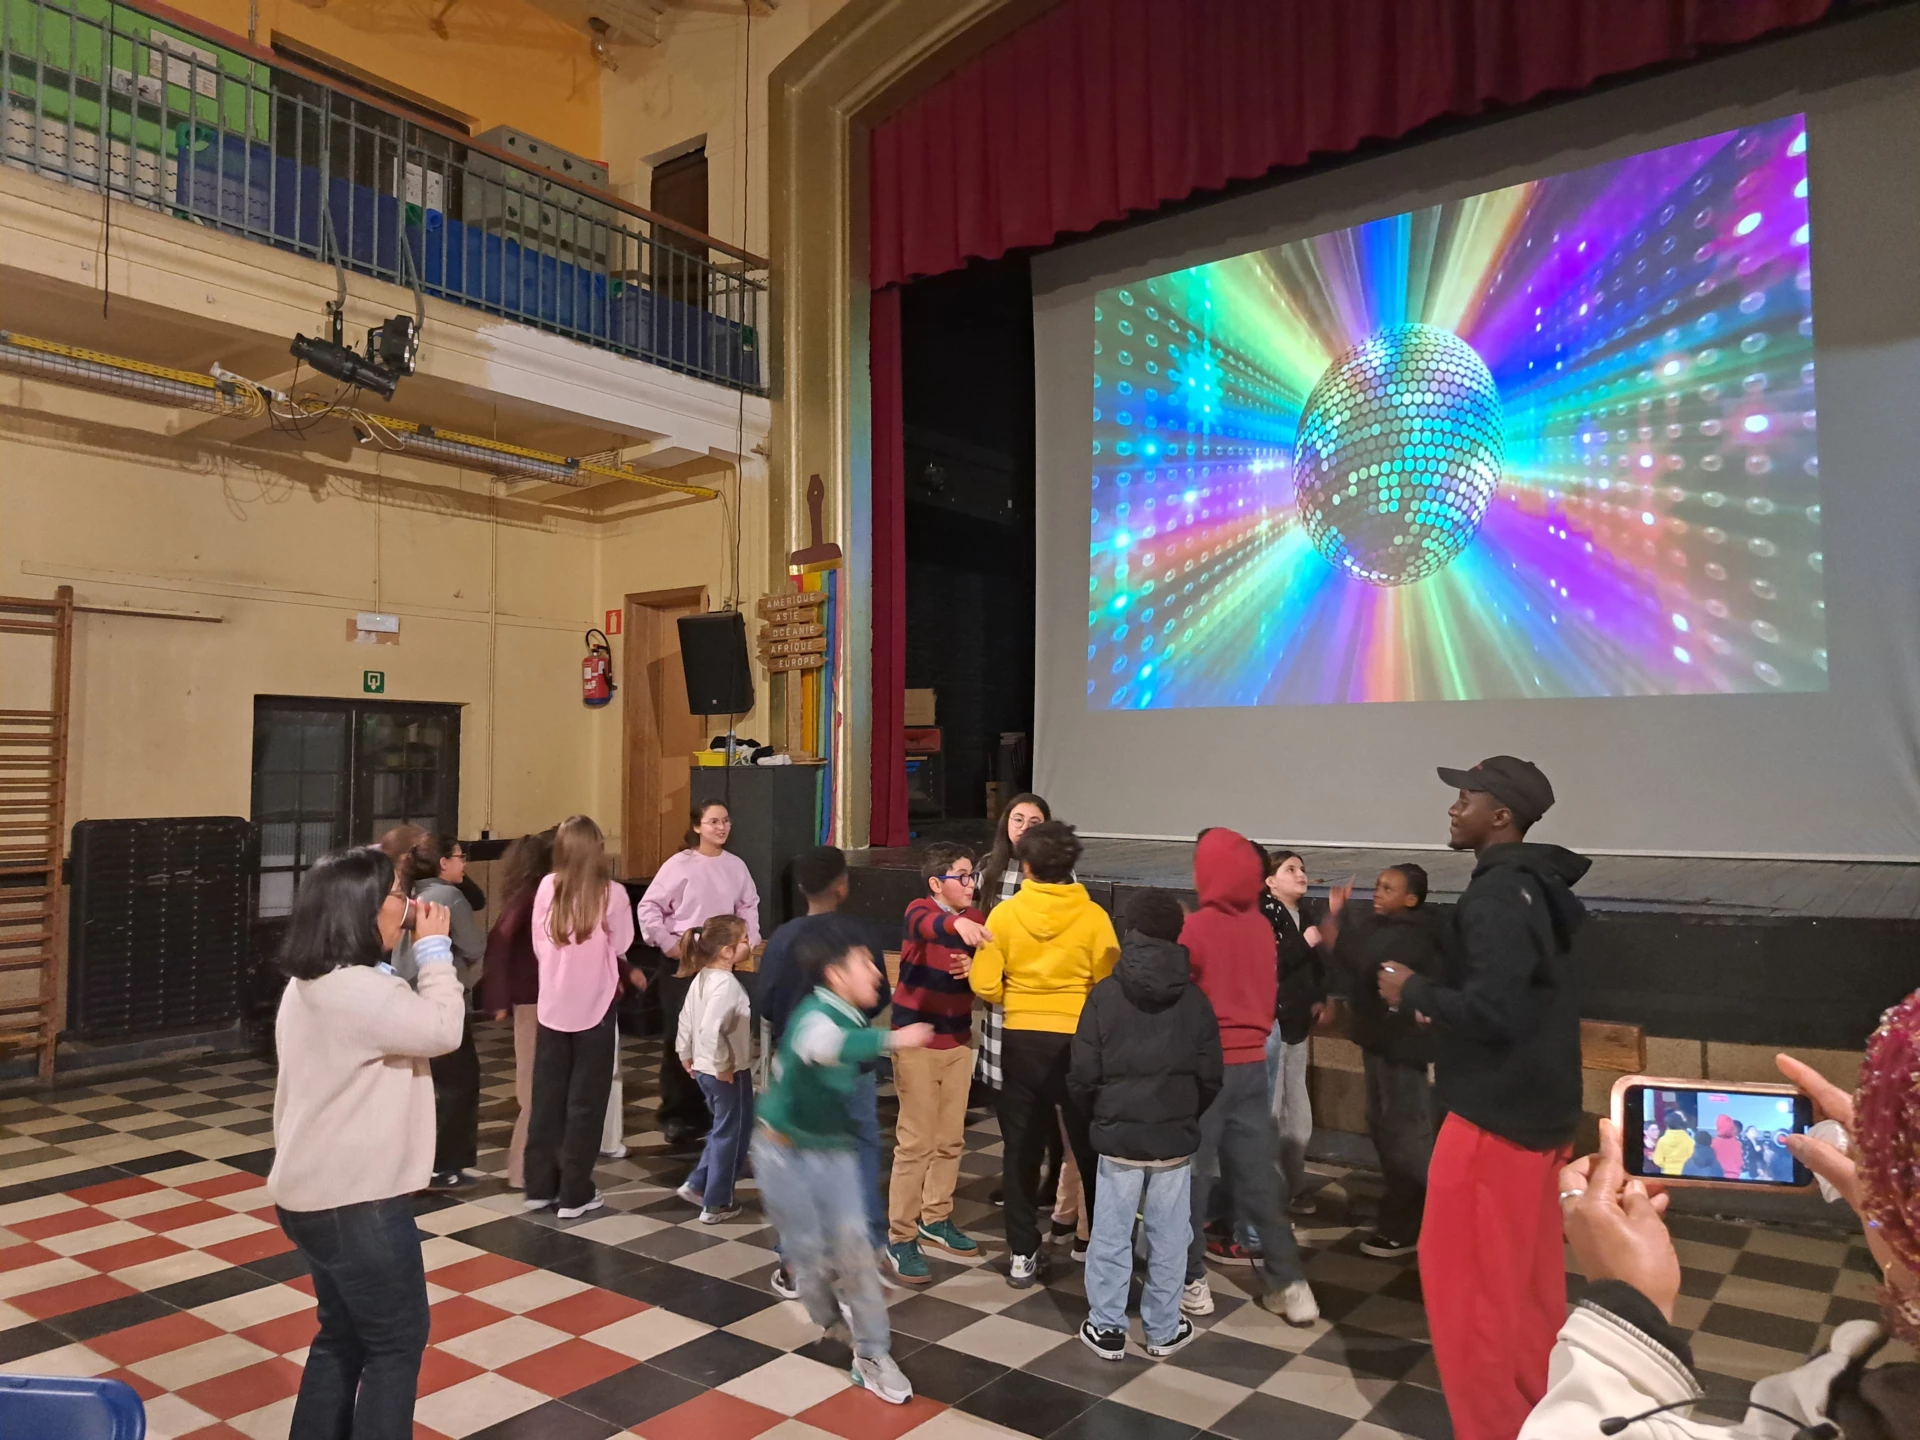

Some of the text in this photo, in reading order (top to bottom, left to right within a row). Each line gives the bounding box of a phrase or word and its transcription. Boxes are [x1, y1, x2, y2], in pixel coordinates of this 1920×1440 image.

[776, 611, 799, 621] ASIE
[771, 642, 812, 654] AFRIQUE
[779, 656, 815, 668] EUROPE
